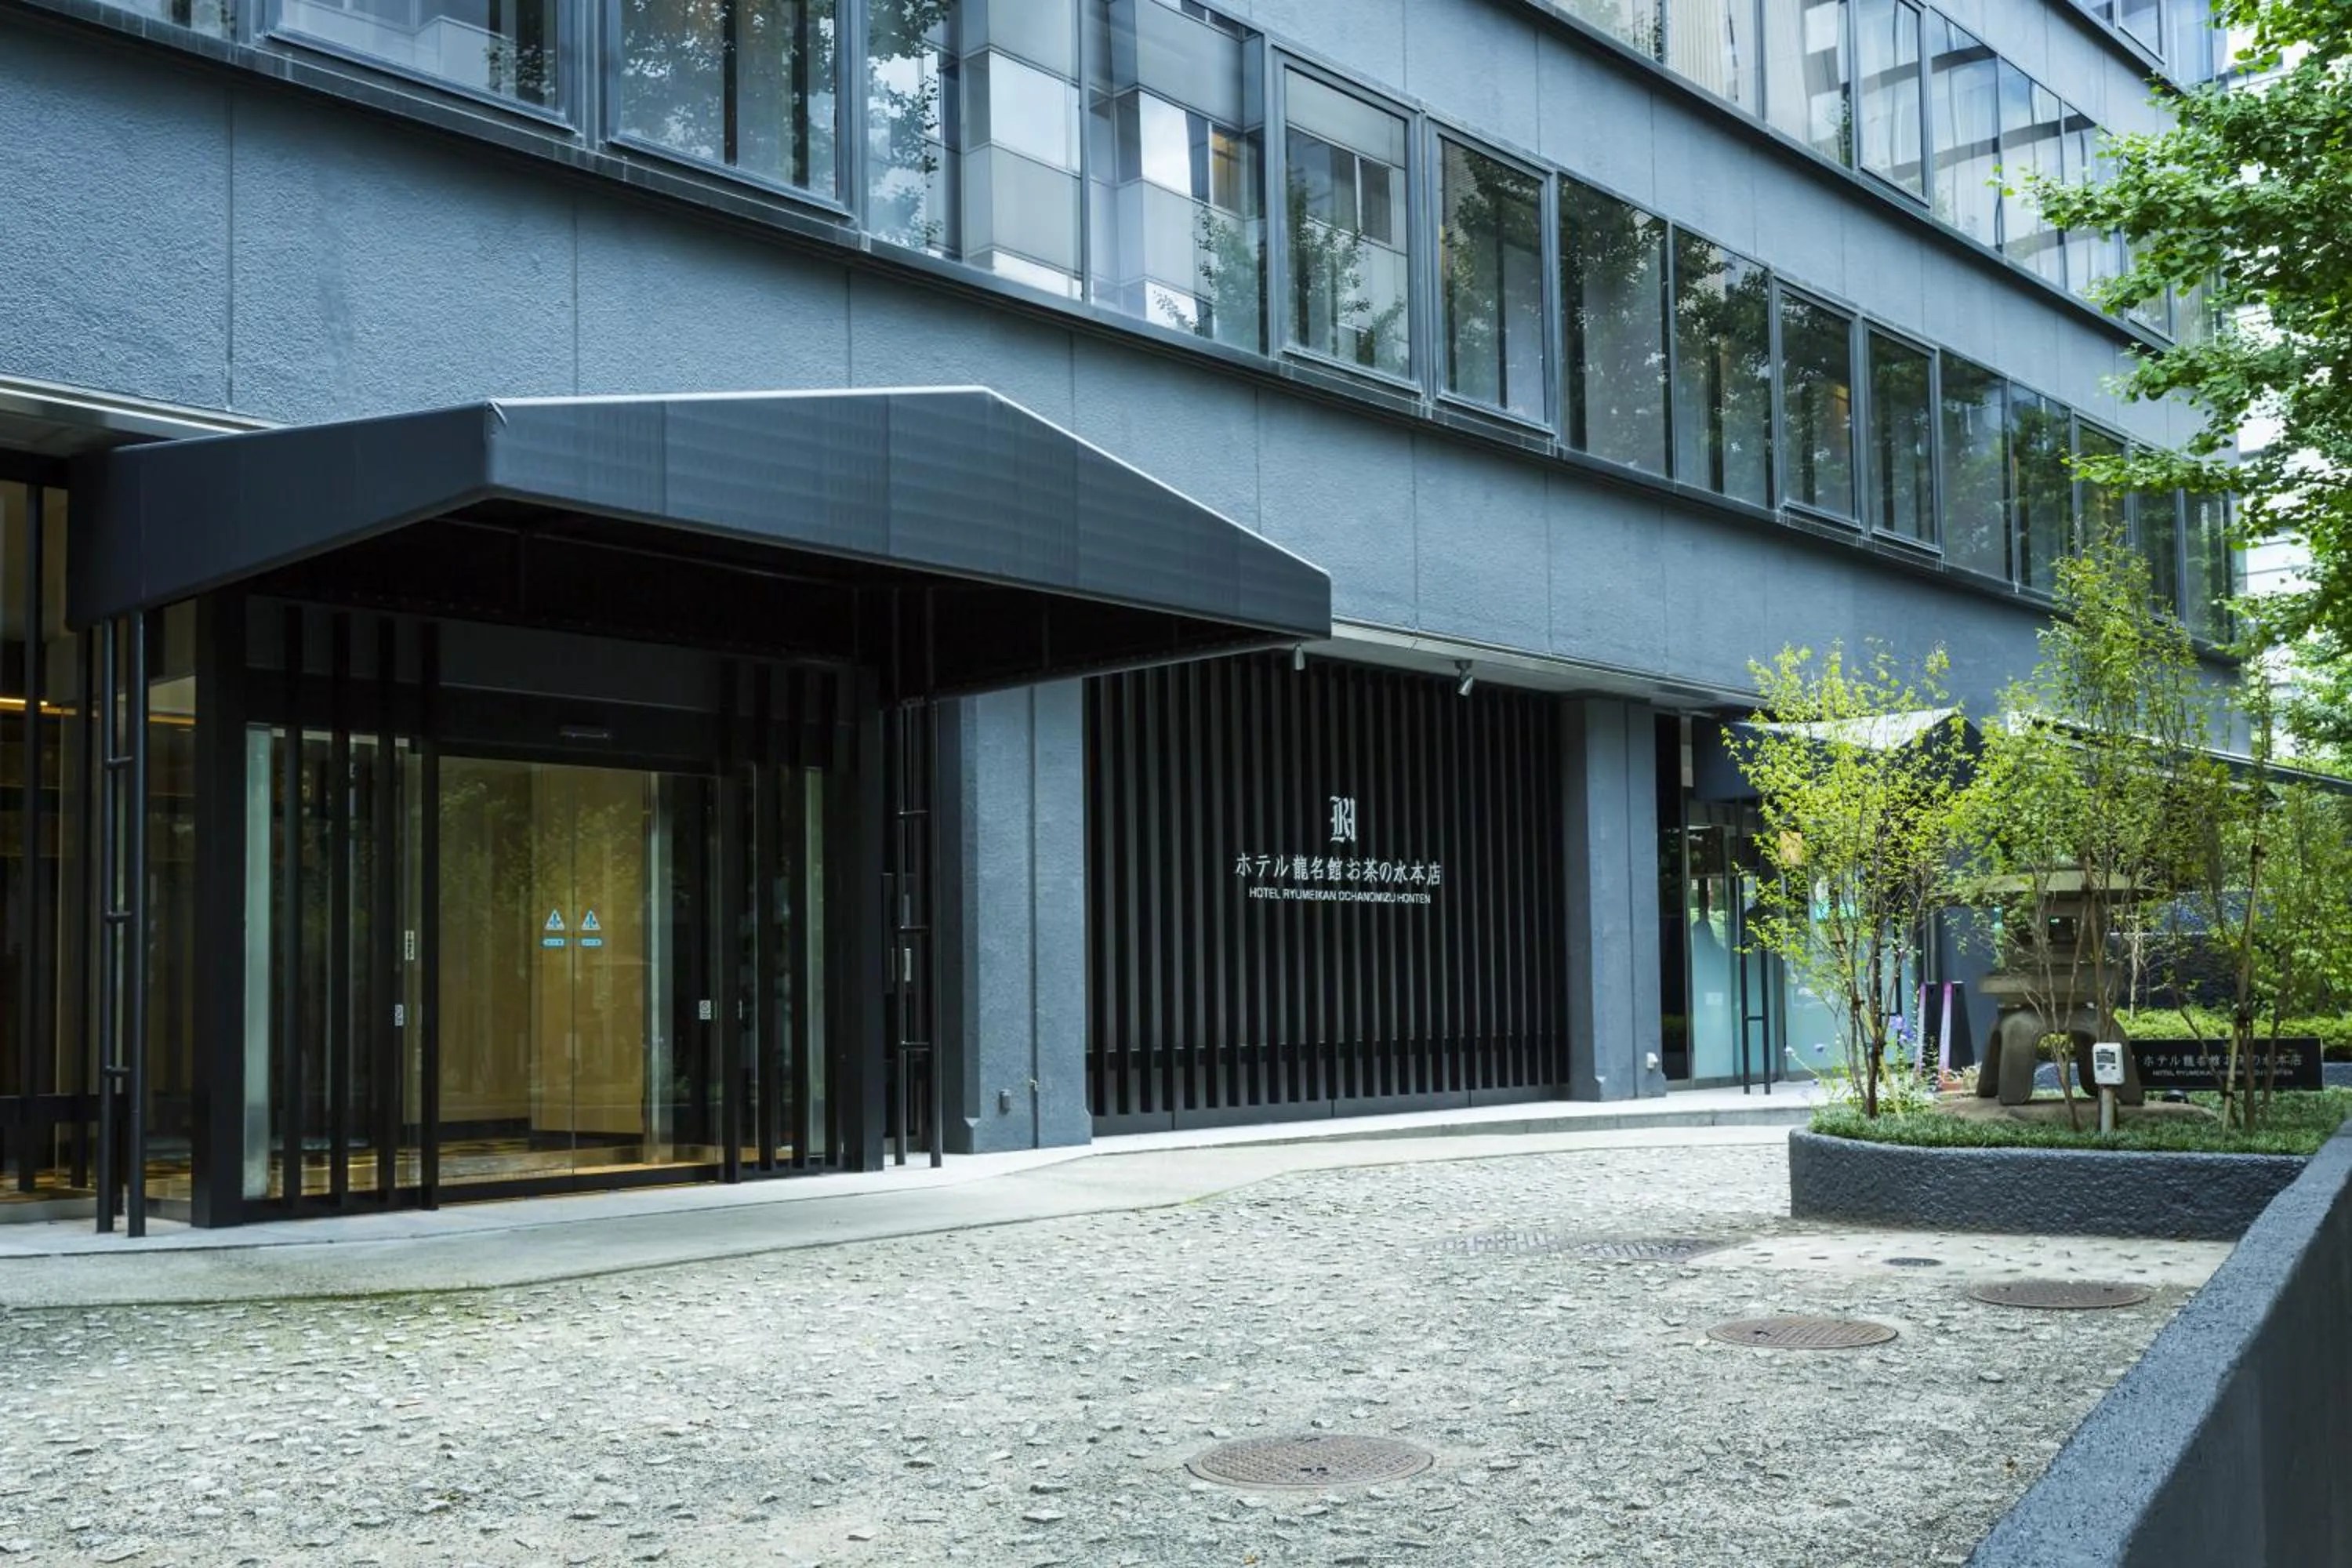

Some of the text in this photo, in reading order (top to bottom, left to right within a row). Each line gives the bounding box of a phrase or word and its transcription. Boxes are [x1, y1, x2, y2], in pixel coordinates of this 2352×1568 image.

[1235, 852, 1442, 886] ホテル龍名館お茶の水本店
[1249, 887, 1431, 904] HOTEL RYUMEIKAN OCHANOMIZU HONTEN
